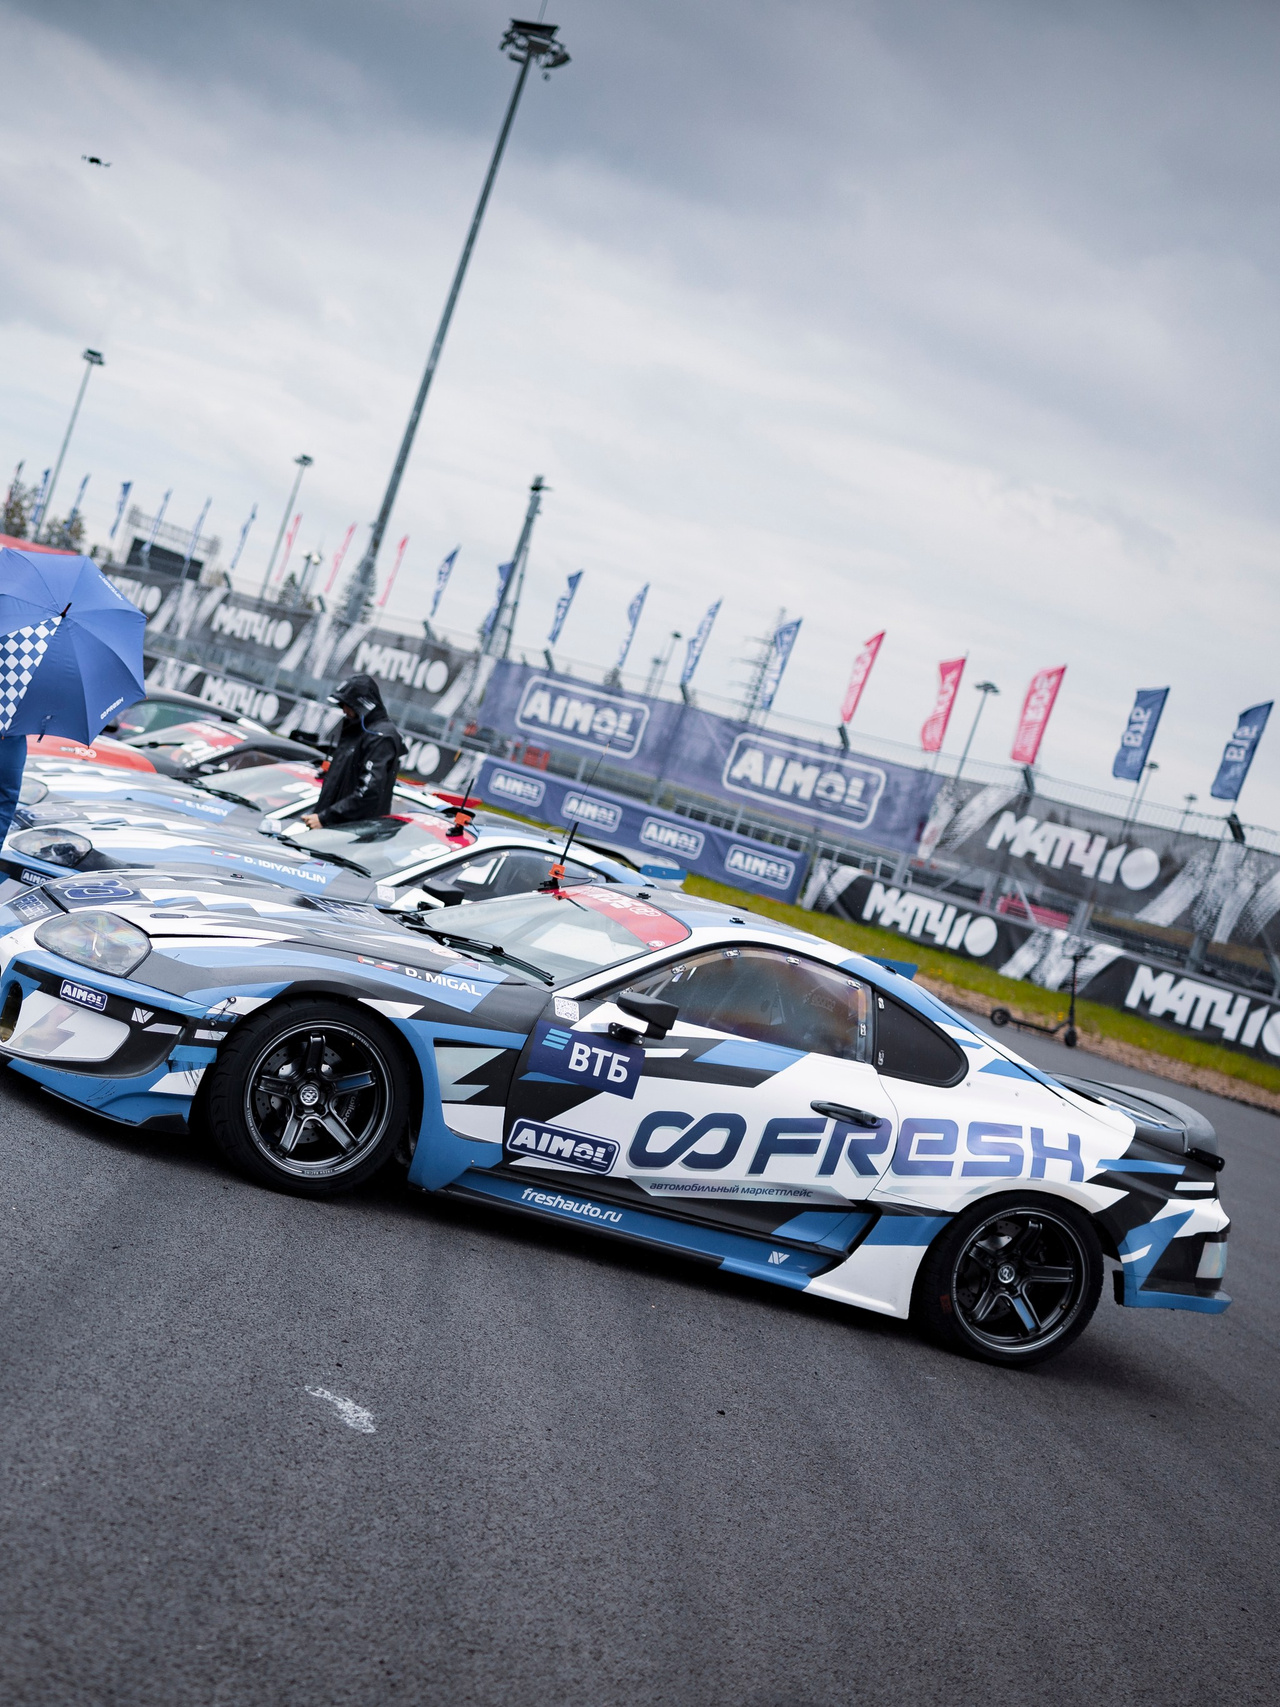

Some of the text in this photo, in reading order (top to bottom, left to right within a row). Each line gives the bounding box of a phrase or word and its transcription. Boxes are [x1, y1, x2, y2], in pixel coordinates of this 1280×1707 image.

[522, 688, 635, 742] AIMOL
[493, 774, 541, 801] AIMOL
[730, 747, 868, 812] AIMOL
[565, 797, 618, 826] AIMOL
[643, 822, 699, 851] AIMOL
[729, 850, 789, 882] AIMOL
[62, 984, 103, 1007] AIMOL
[404, 967, 482, 997] D. MIGAL
[568, 1042, 631, 1083] ВТБ
[512, 1127, 609, 1166] AIMOL
[520, 1188, 623, 1223] freshauto.ru
[649, 1181, 814, 1199] автомобильный маркетплейс
